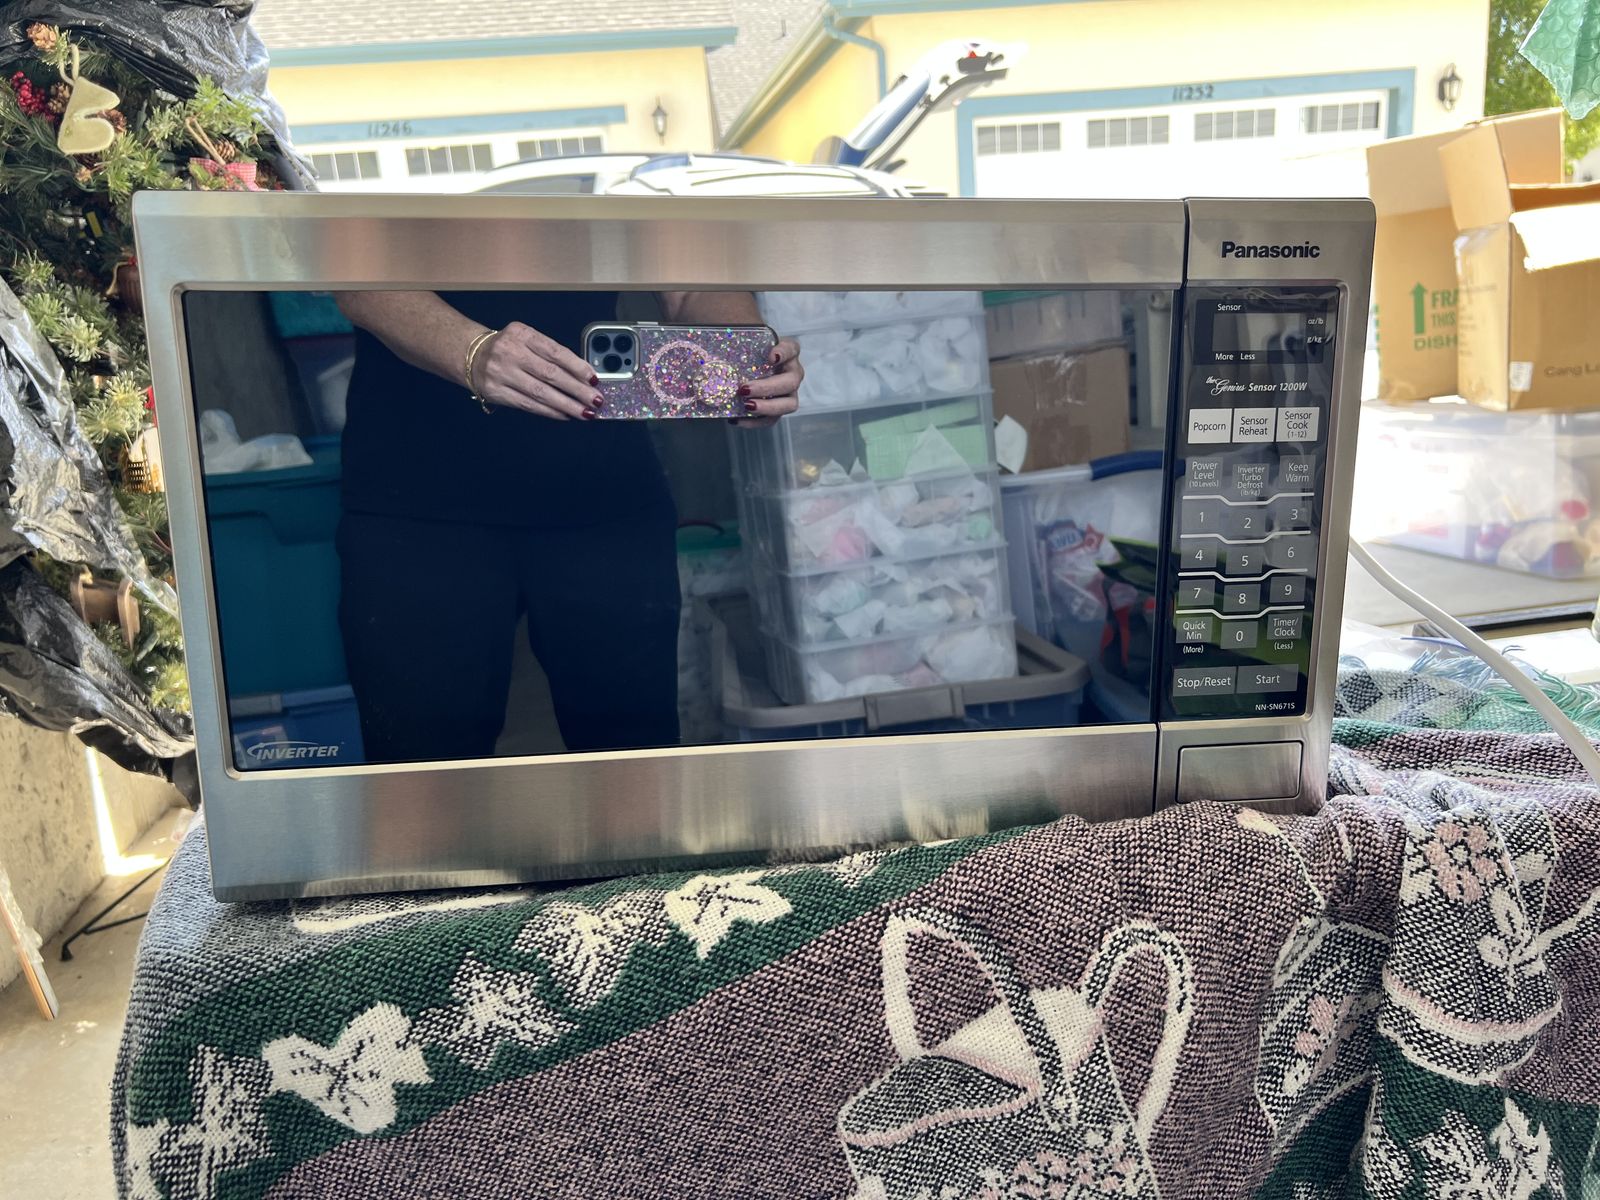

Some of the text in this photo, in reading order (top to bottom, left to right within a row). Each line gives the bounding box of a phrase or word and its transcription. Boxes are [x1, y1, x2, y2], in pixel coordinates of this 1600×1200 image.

[1221, 240, 1320, 258] Panasonic
[1217, 303, 1242, 311] Sensor
[1432, 312, 1456, 328] THIS
[1307, 335, 1323, 344] g/kg
[1215, 353, 1234, 361] More
[1211, 379, 1247, 396] Genius
[1248, 382, 1277, 392] Sensor
[1279, 382, 1308, 391] 1200W
[1284, 410, 1313, 420] Sensor
[1240, 416, 1268, 425] Sensor
[1286, 420, 1309, 429] Cook
[1193, 421, 1227, 432] Popcorn
[1239, 426, 1268, 436] Reheat
[1287, 430, 1307, 439] (1-12)
[1191, 461, 1218, 471] Power
[1237, 466, 1265, 474] Inverter
[1288, 462, 1309, 473] Keep
[1194, 470, 1215, 480] Level
[1241, 473, 1262, 481] Turbo
[1285, 474, 1310, 483] Warm
[1237, 481, 1264, 489] Defrost
[1199, 511, 1204, 522] 1
[1290, 508, 1298, 520] 3
[1243, 517, 1251, 529] 2
[1195, 549, 1203, 561] 4
[1287, 546, 1295, 558] 6
[1241, 555, 1249, 567] 5
[1193, 587, 1201, 599] 7
[1284, 584, 1292, 596] 9
[1238, 593, 1246, 605] 8
[1182, 621, 1206, 631] Quick
[1273, 617, 1299, 627] Timer/
[1186, 631, 1202, 640] Min
[1235, 630, 1243, 642] 0
[1274, 627, 1295, 637] Clock
[1182, 645, 1204, 654] (More)
[1274, 641, 1293, 651] (Less)
[1177, 676, 1231, 689] Stop/Reset
[1256, 674, 1280, 685] Start
[1255, 702, 1296, 711] NN-SN671S
[256, 745, 339, 760] INVERTER
